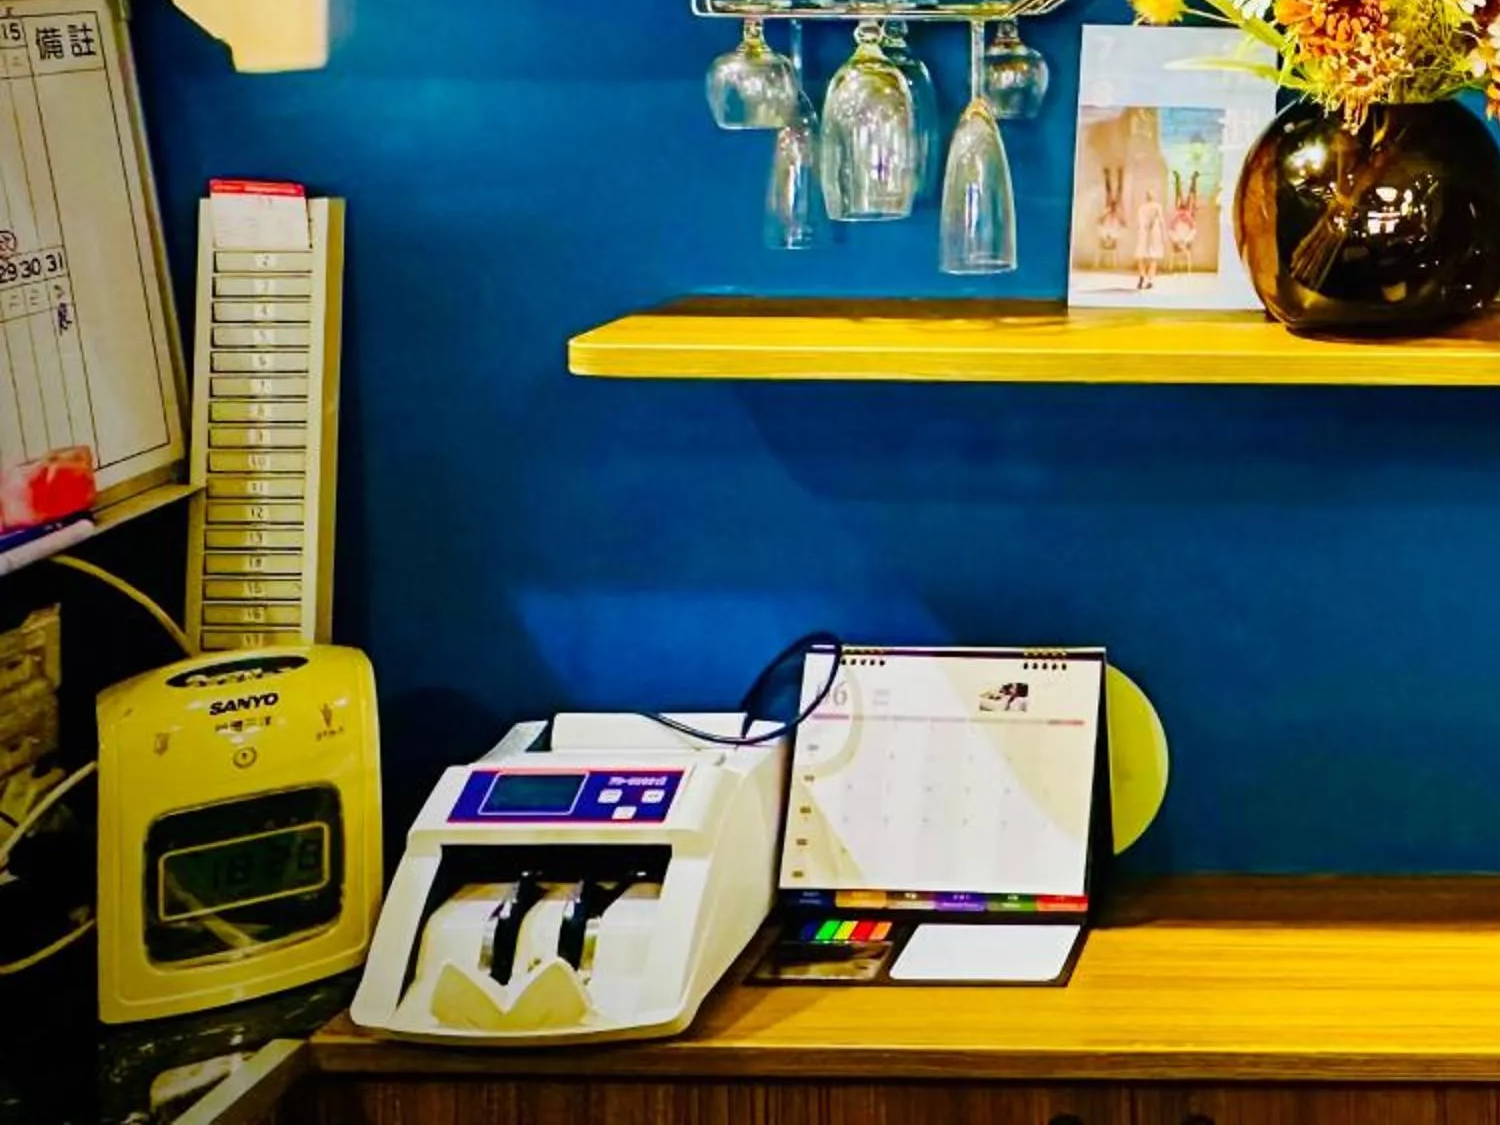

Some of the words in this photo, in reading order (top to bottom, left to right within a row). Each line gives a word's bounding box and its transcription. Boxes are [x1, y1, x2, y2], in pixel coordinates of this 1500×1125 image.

[1, 22, 21, 42] 15
[36, 22, 97, 60] 備註
[20, 258, 41, 278] 30
[46, 252, 63, 272] 31
[209, 693, 279, 716] SANYO
